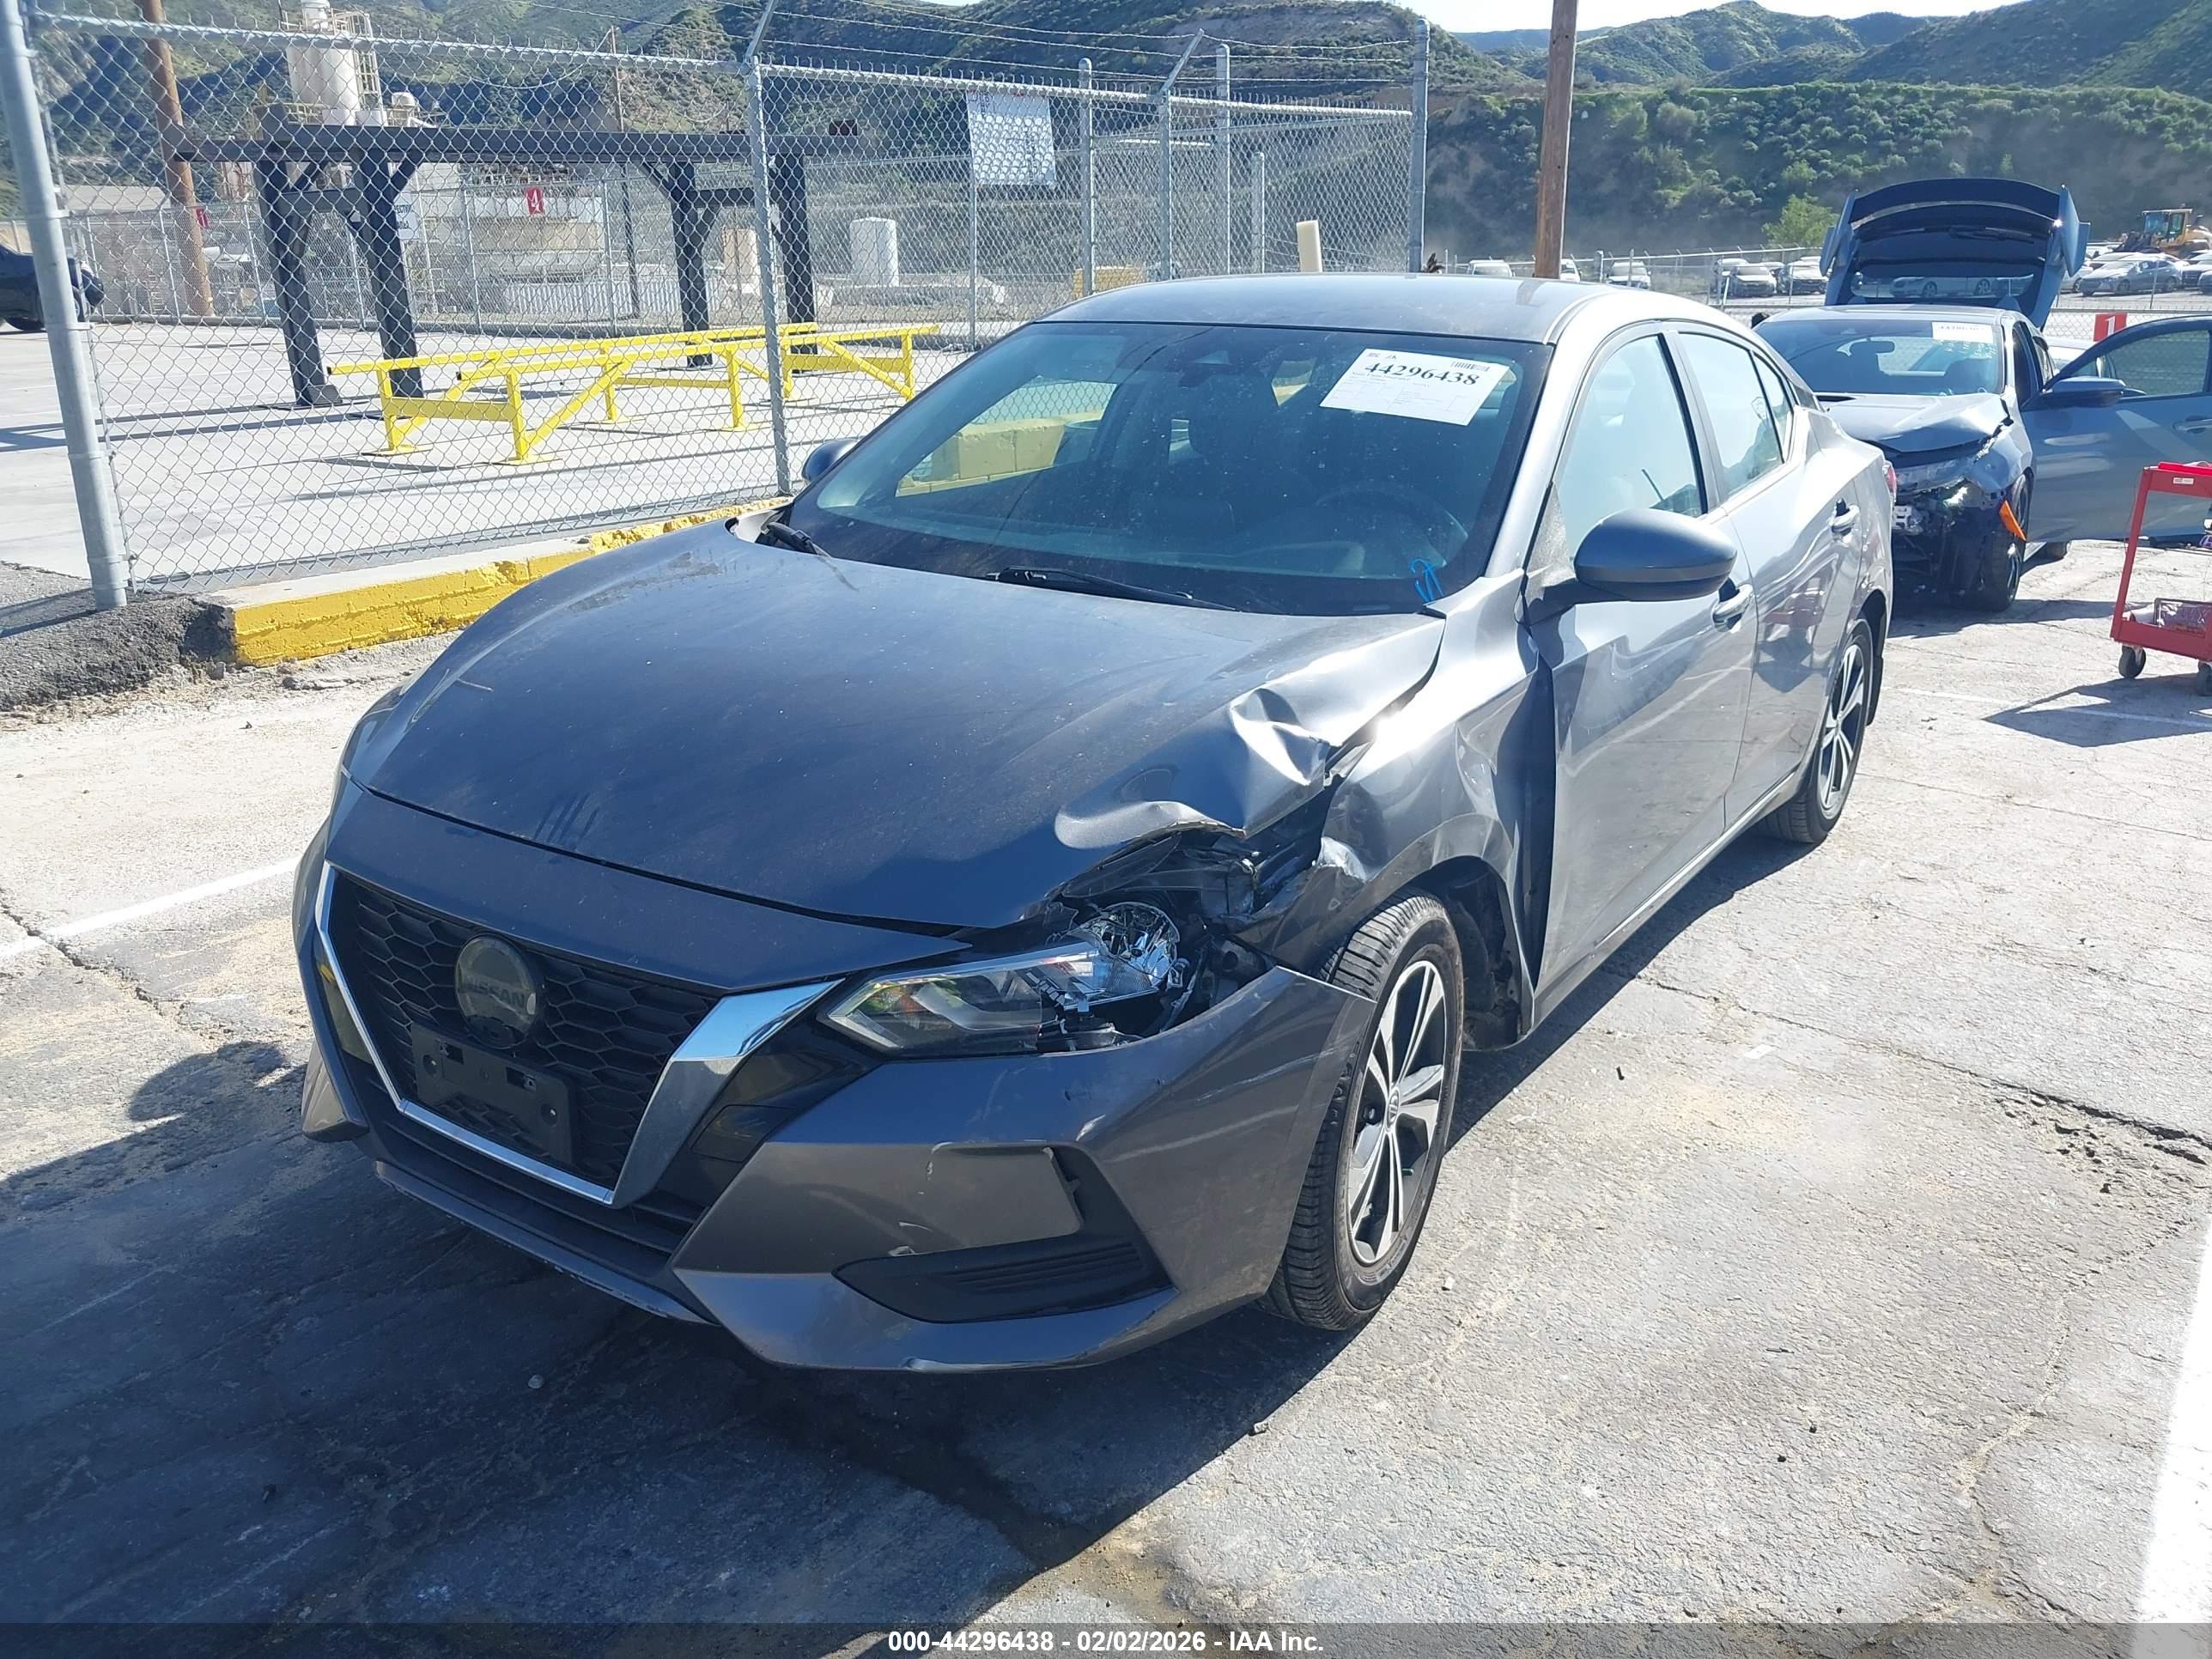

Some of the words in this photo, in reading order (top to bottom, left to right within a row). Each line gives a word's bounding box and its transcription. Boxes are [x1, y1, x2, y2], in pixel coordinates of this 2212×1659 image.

[532, 189, 540, 212] 4
[2105, 315, 2116, 337] 1
[1364, 362, 1480, 386] 44296438
